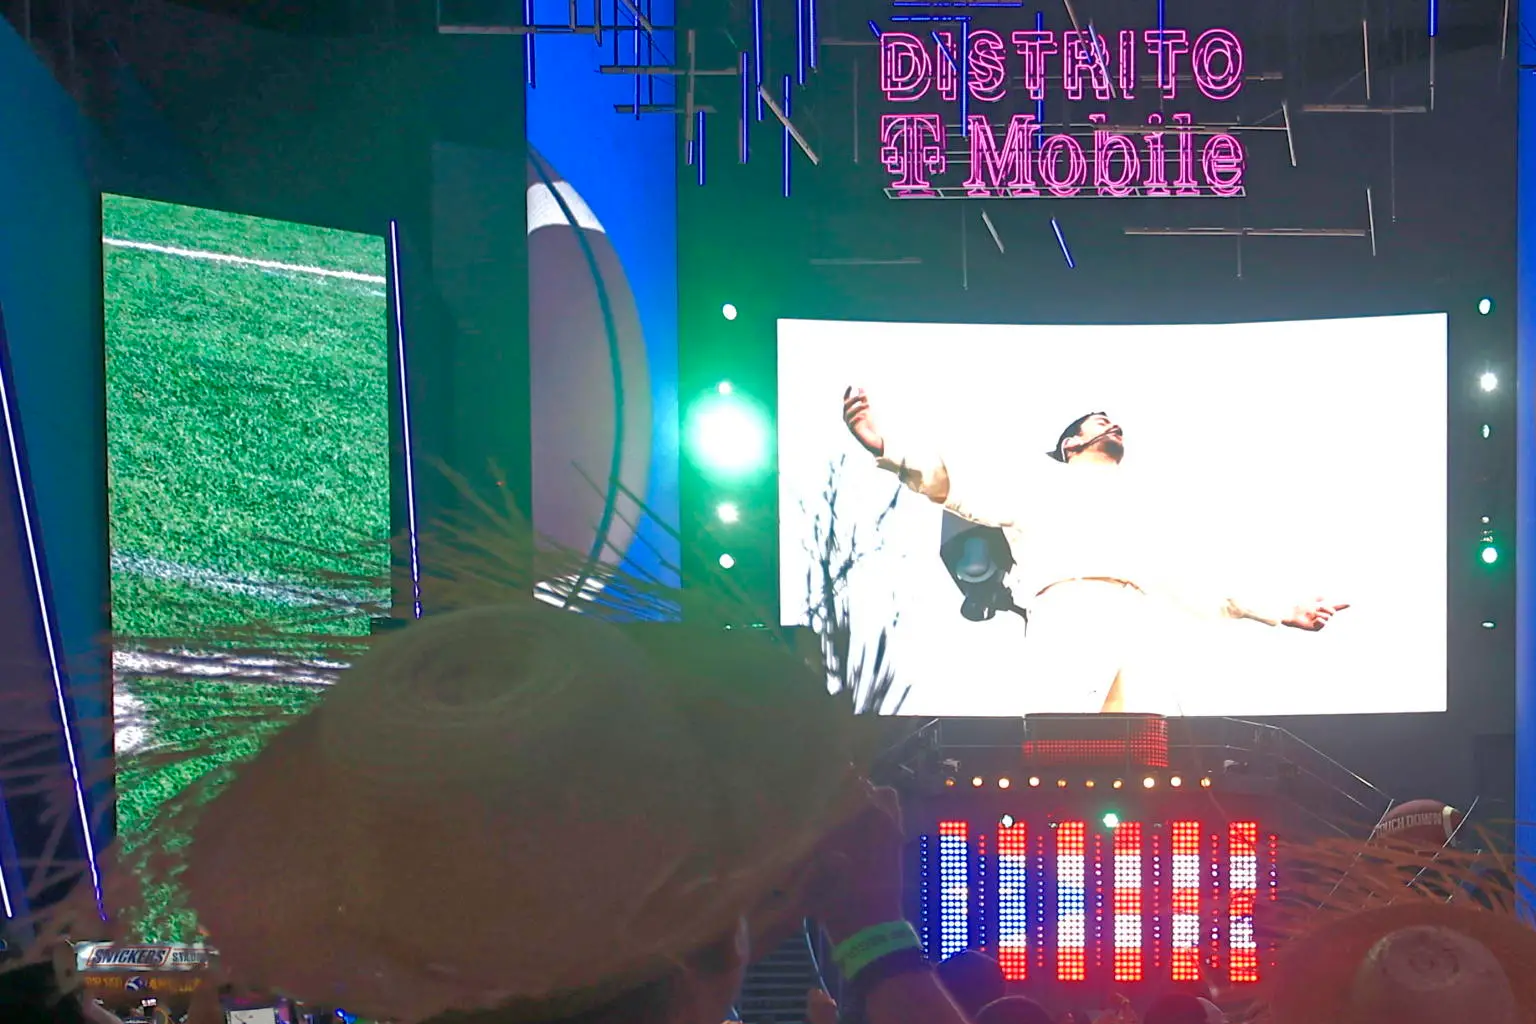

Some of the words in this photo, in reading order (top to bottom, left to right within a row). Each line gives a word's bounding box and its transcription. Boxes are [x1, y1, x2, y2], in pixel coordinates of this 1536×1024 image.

[880, 29, 1243, 100] DISTRITO
[881, 114, 945, 196] T
[963, 113, 1244, 196] Mobile
[93, 948, 166, 964] SNICKERS
